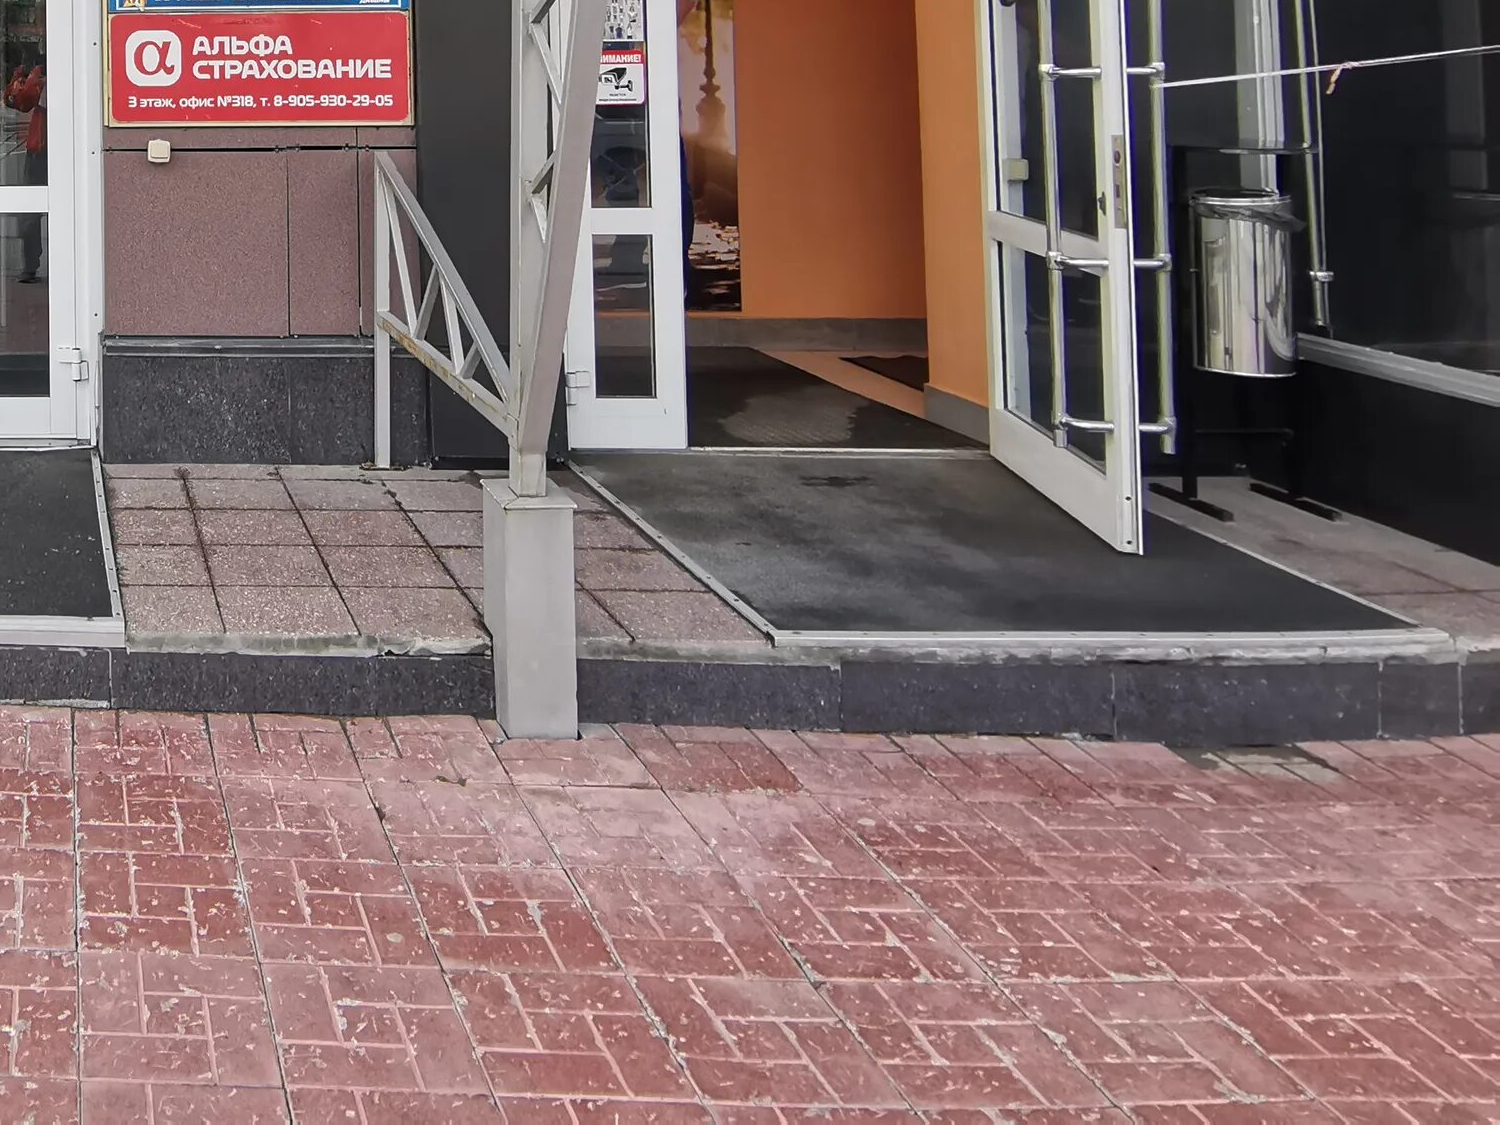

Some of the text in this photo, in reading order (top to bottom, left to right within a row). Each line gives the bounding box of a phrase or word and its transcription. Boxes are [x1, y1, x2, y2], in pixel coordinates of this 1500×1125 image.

[192, 33, 293, 57] АЛЬФА
[192, 58, 393, 80] СТРАХОВАНИЕ
[127, 96, 138, 108] 3
[140, 96, 176, 109] этаж,
[179, 93, 215, 109] офис
[260, 96, 272, 107] т.
[273, 94, 394, 107] 8-905-930-29-05
